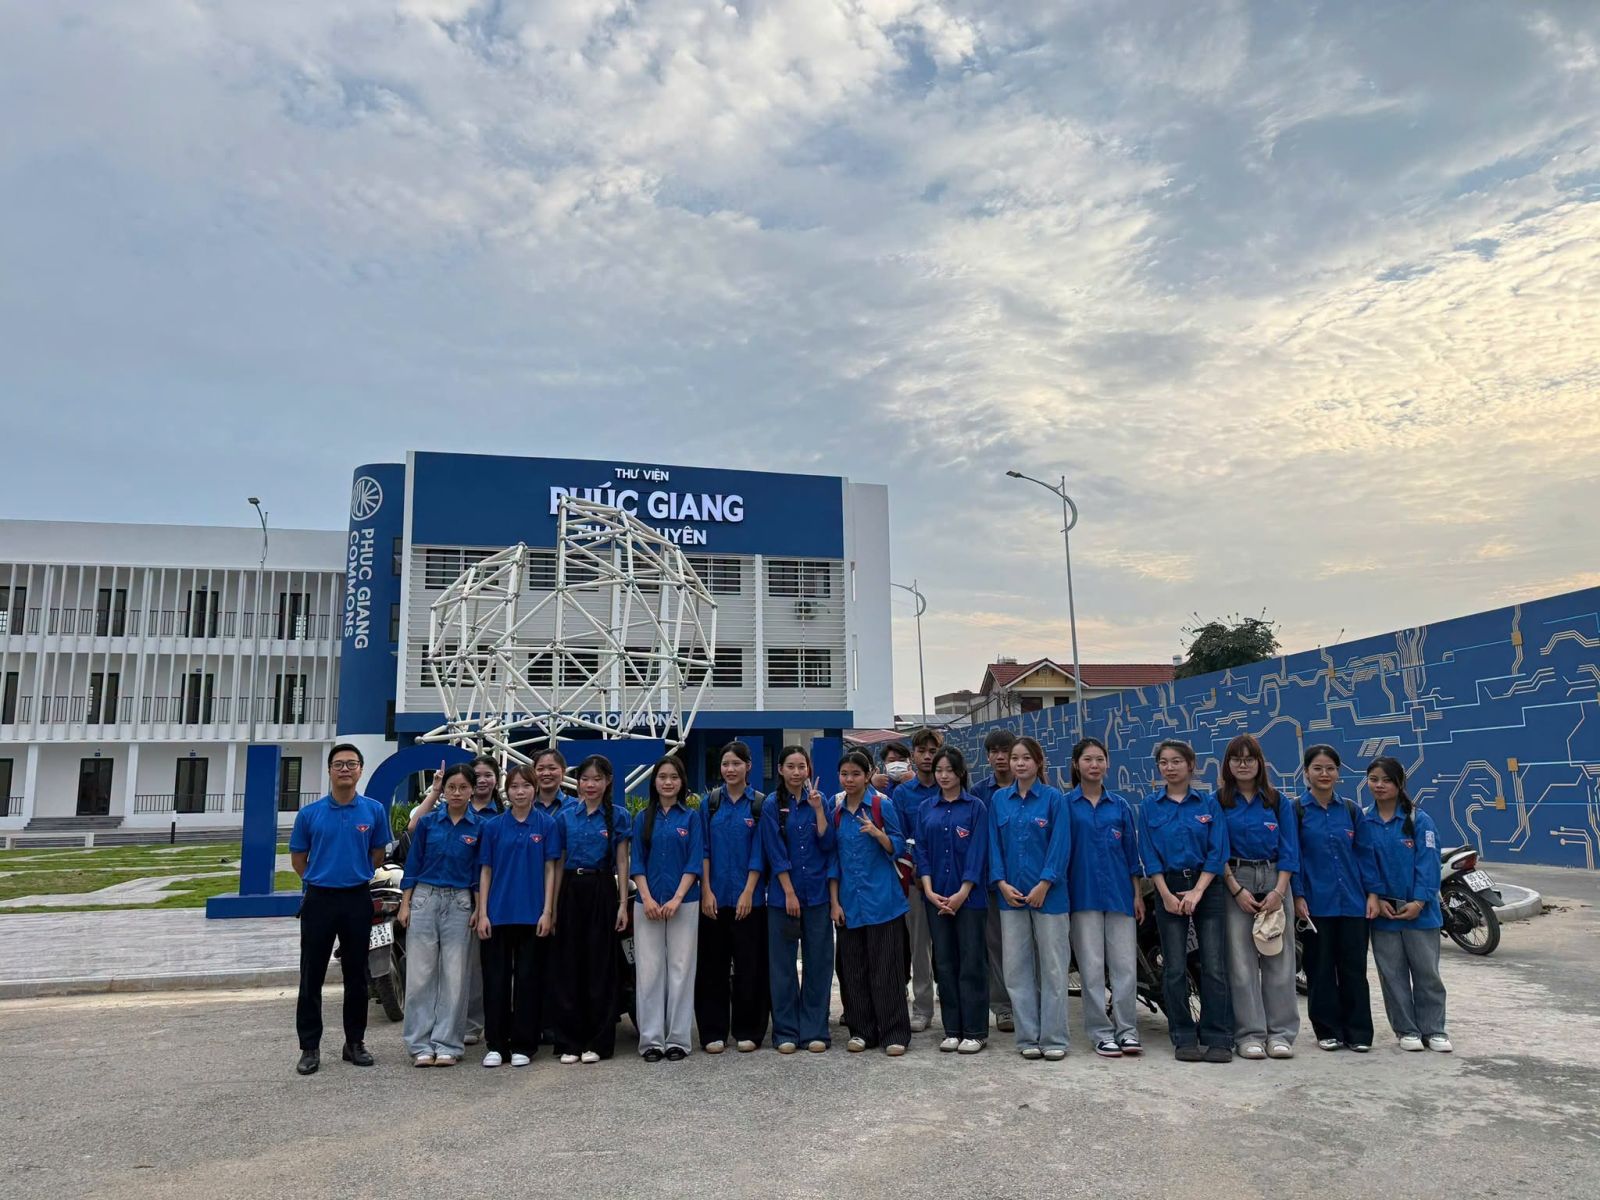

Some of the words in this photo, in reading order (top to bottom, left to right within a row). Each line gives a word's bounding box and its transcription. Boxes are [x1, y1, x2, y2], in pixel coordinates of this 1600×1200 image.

[615, 468, 639, 479] THƯ
[643, 468, 670, 483] VIỆN
[549, 481, 639, 518] PHÚC
[648, 490, 744, 523] GIANG
[358, 528, 375, 580] PHUC
[344, 530, 359, 638] COMMONS
[354, 586, 372, 649] GIANG
[594, 713, 679, 727] COMONS
